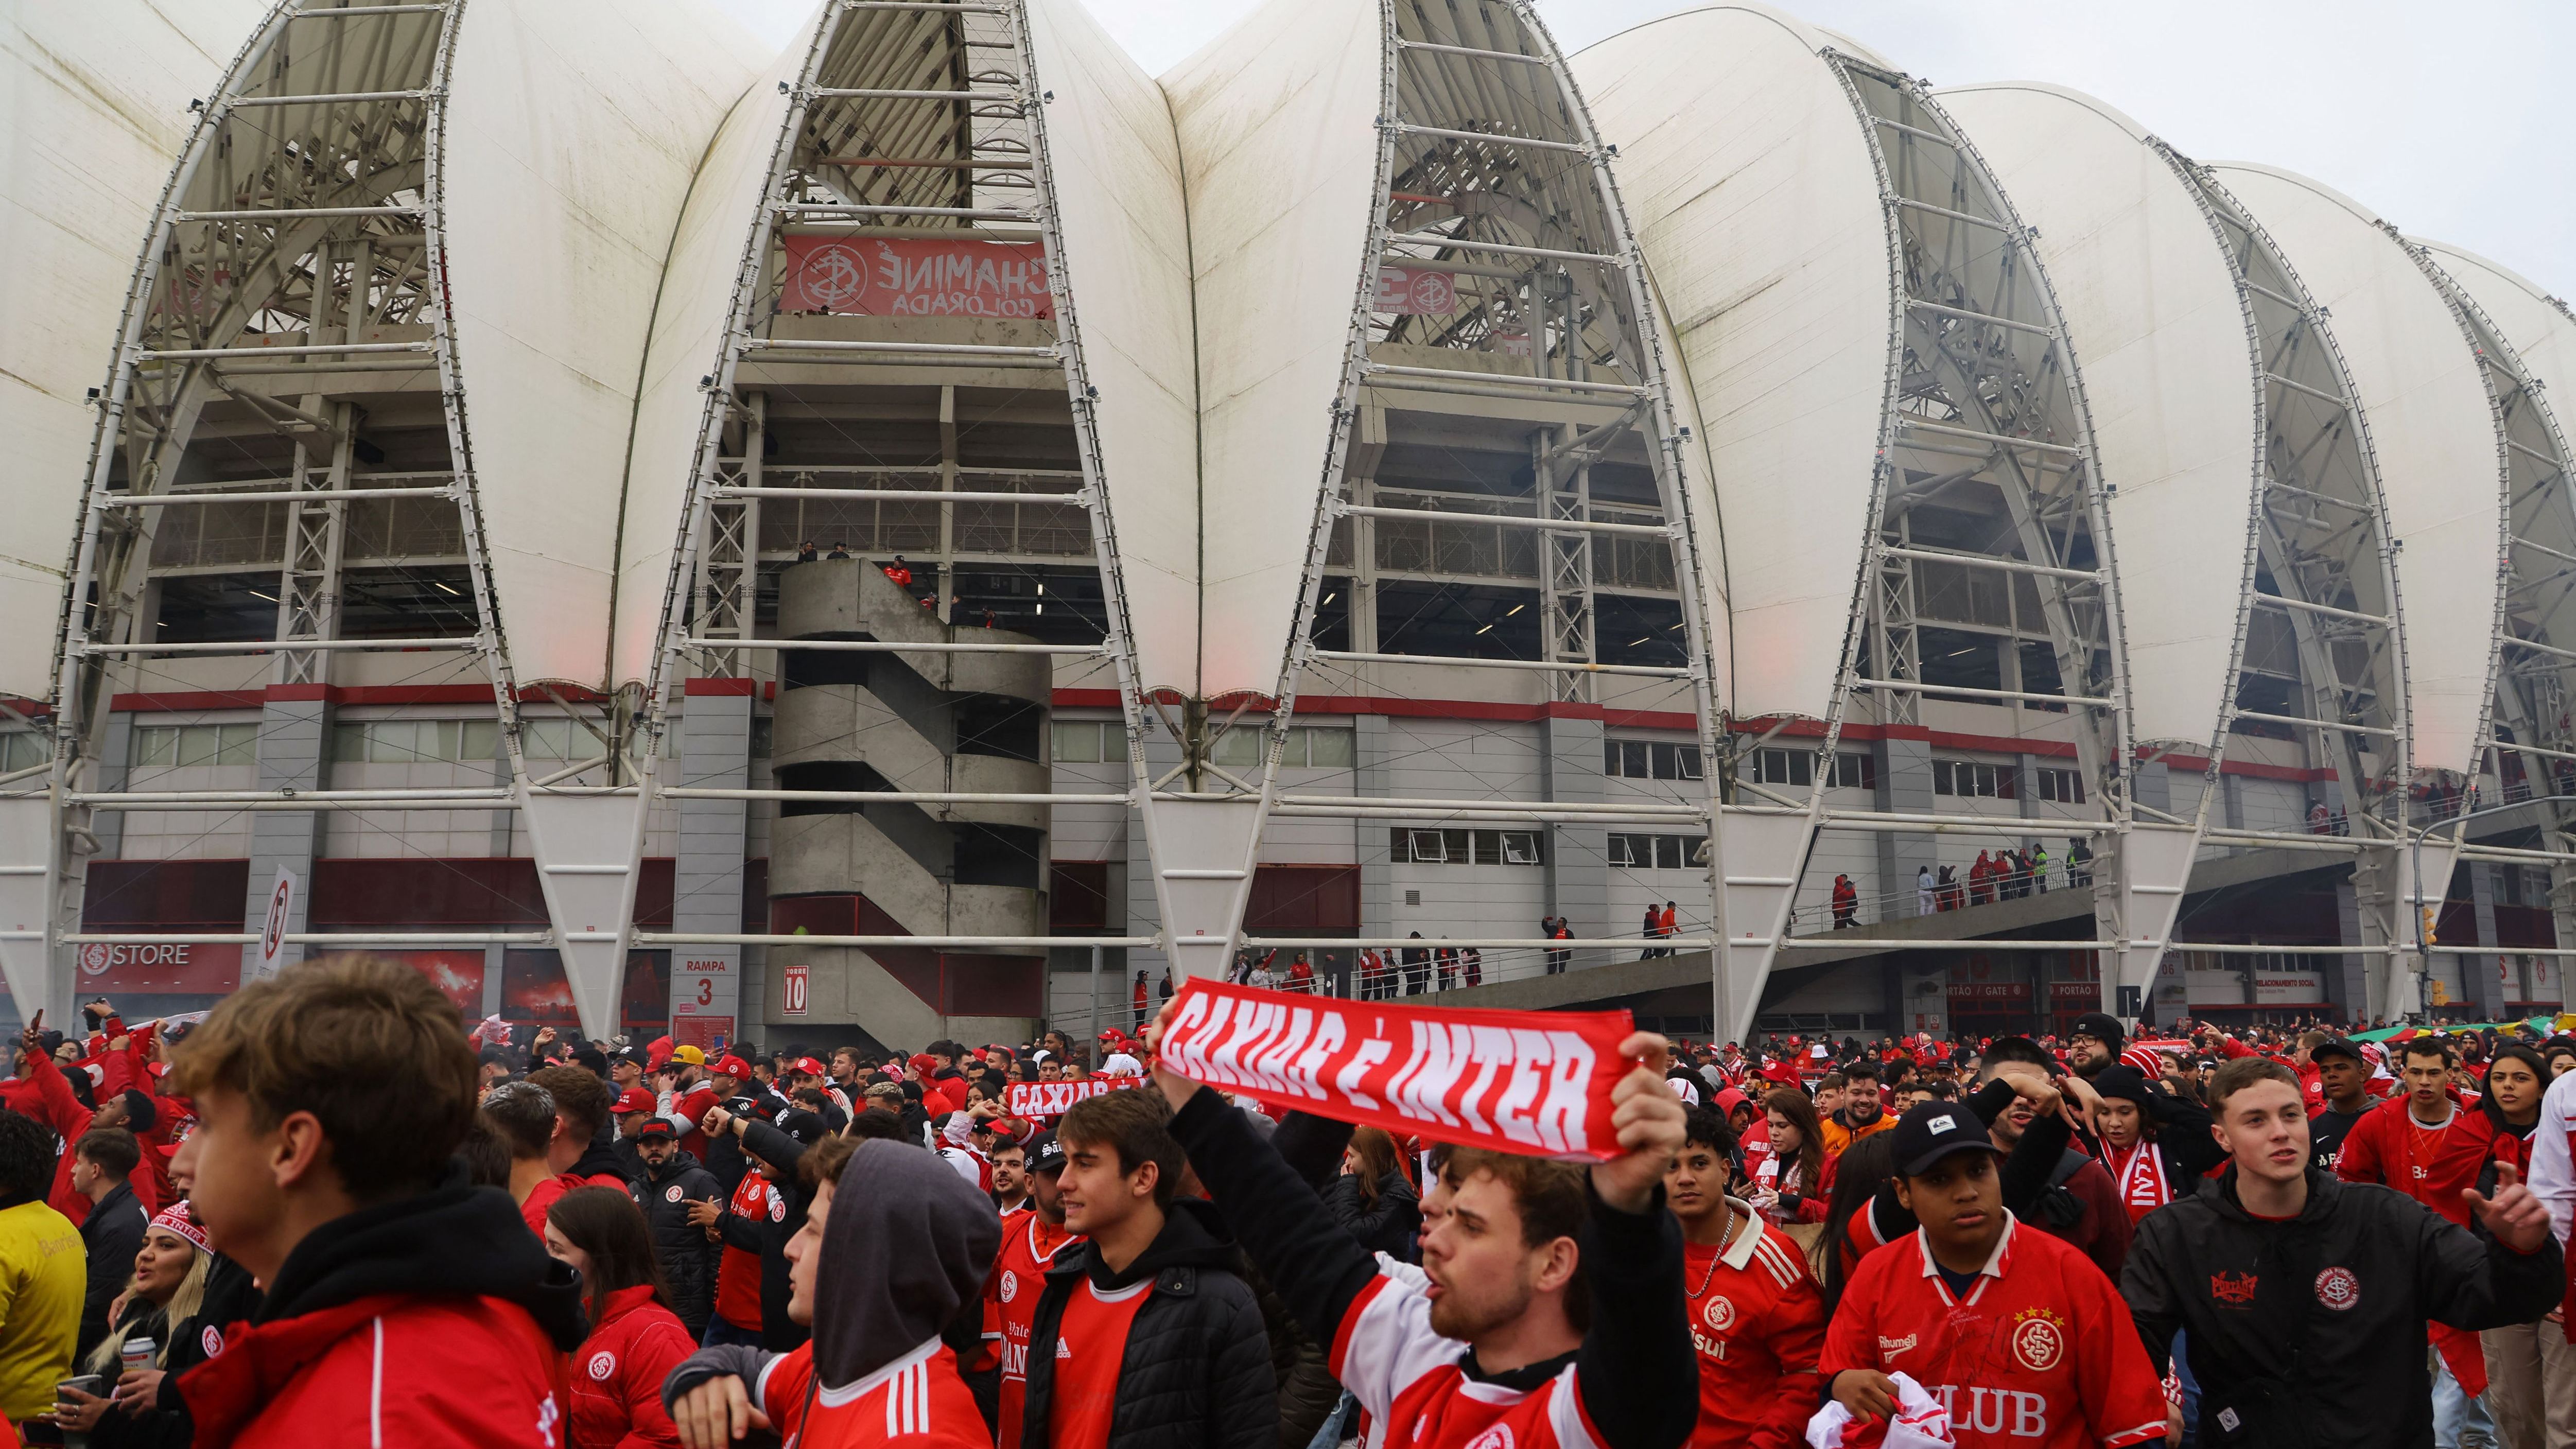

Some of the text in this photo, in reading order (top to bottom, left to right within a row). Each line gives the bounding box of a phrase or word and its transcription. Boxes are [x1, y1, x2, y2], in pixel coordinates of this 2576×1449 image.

[112, 945, 190, 965] STORE
[687, 961, 725, 971] RAMPA
[2163, 964, 2174, 975] 06
[698, 979, 712, 1005] 3
[786, 976, 804, 1009] 10
[1986, 986, 2007, 996] GATE
[2060, 984, 2091, 995] PORTÃO
[1161, 991, 1596, 1153] CAXIAS É INTER
[169, 1219, 201, 1241] INTER
[1008, 1320, 1029, 1338] Vale
